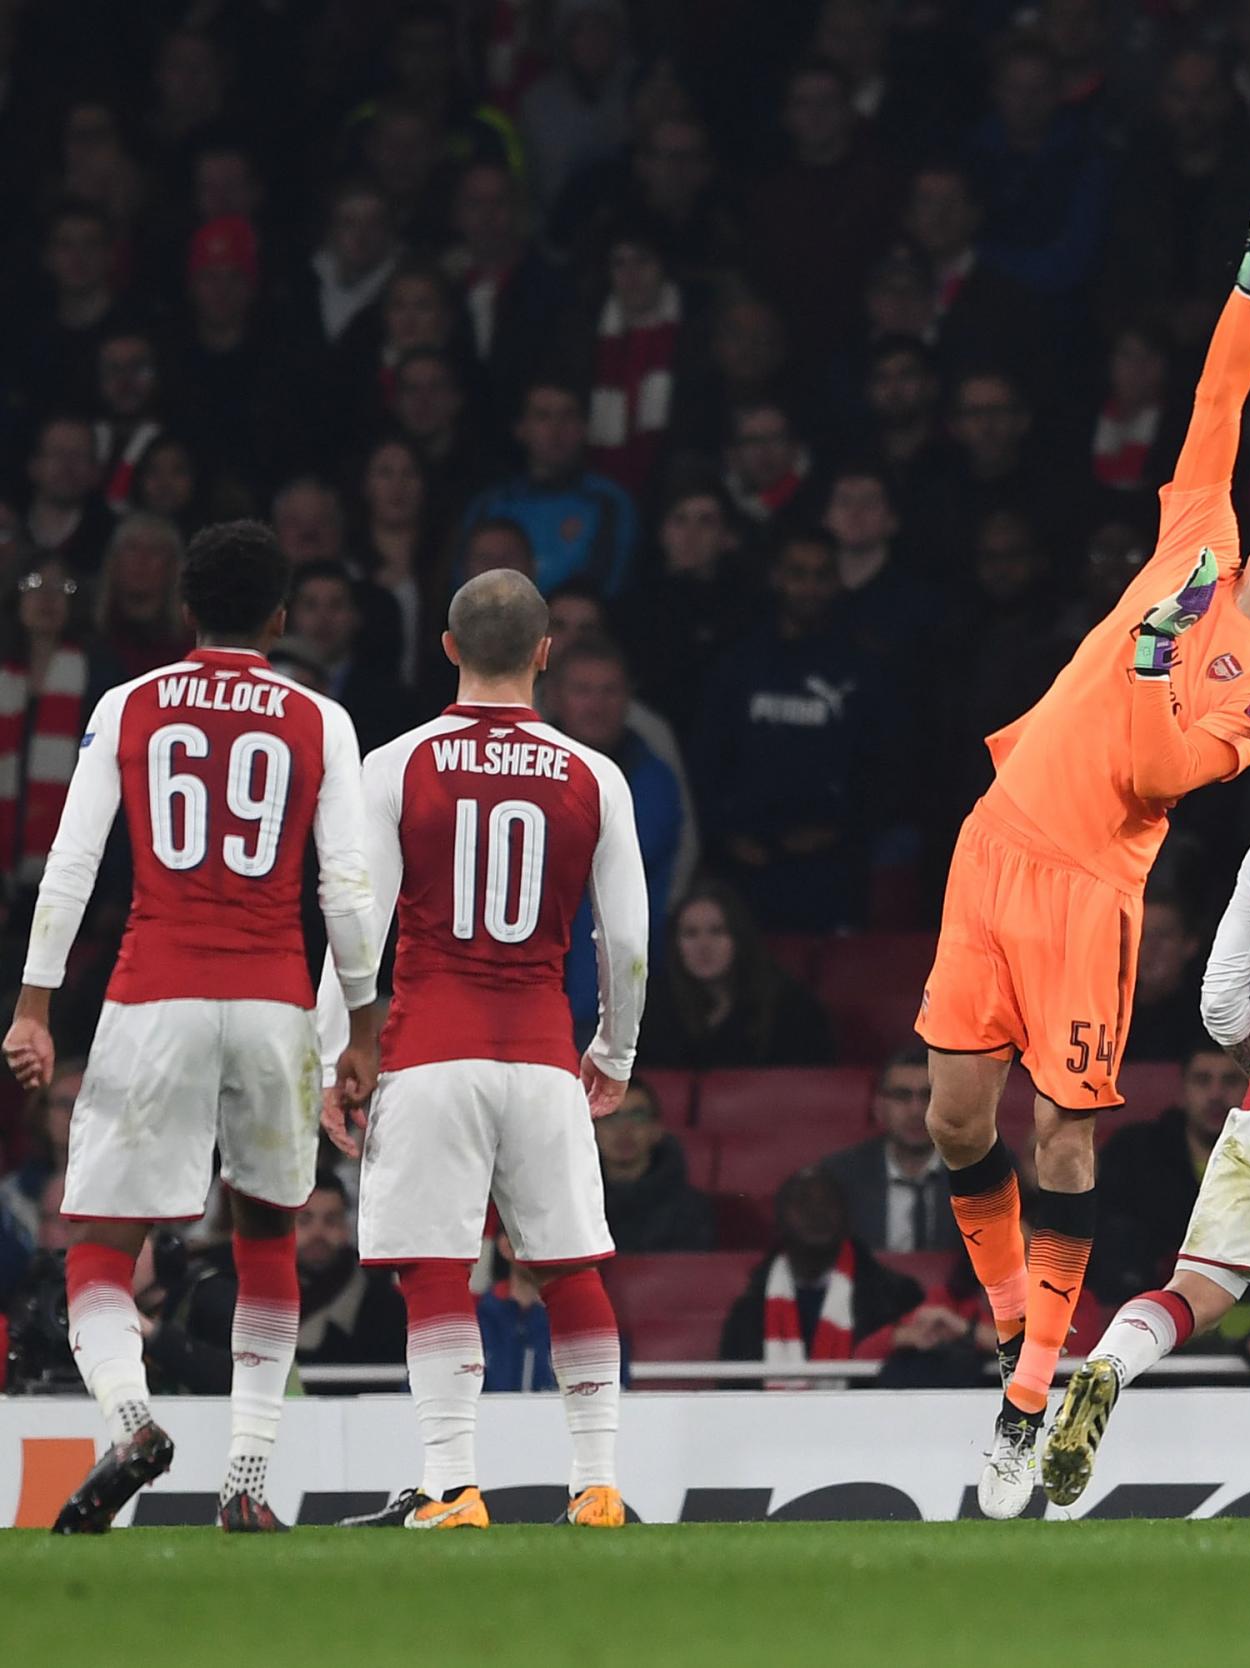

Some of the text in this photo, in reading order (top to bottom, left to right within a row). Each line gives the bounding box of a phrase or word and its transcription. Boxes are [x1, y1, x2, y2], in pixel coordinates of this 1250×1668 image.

[157, 677, 289, 718] WILLOCK
[432, 739, 571, 782] WILSHERE
[149, 723, 291, 877] 69
[453, 798, 546, 943] 10
[1066, 1020, 1113, 1077] 54
